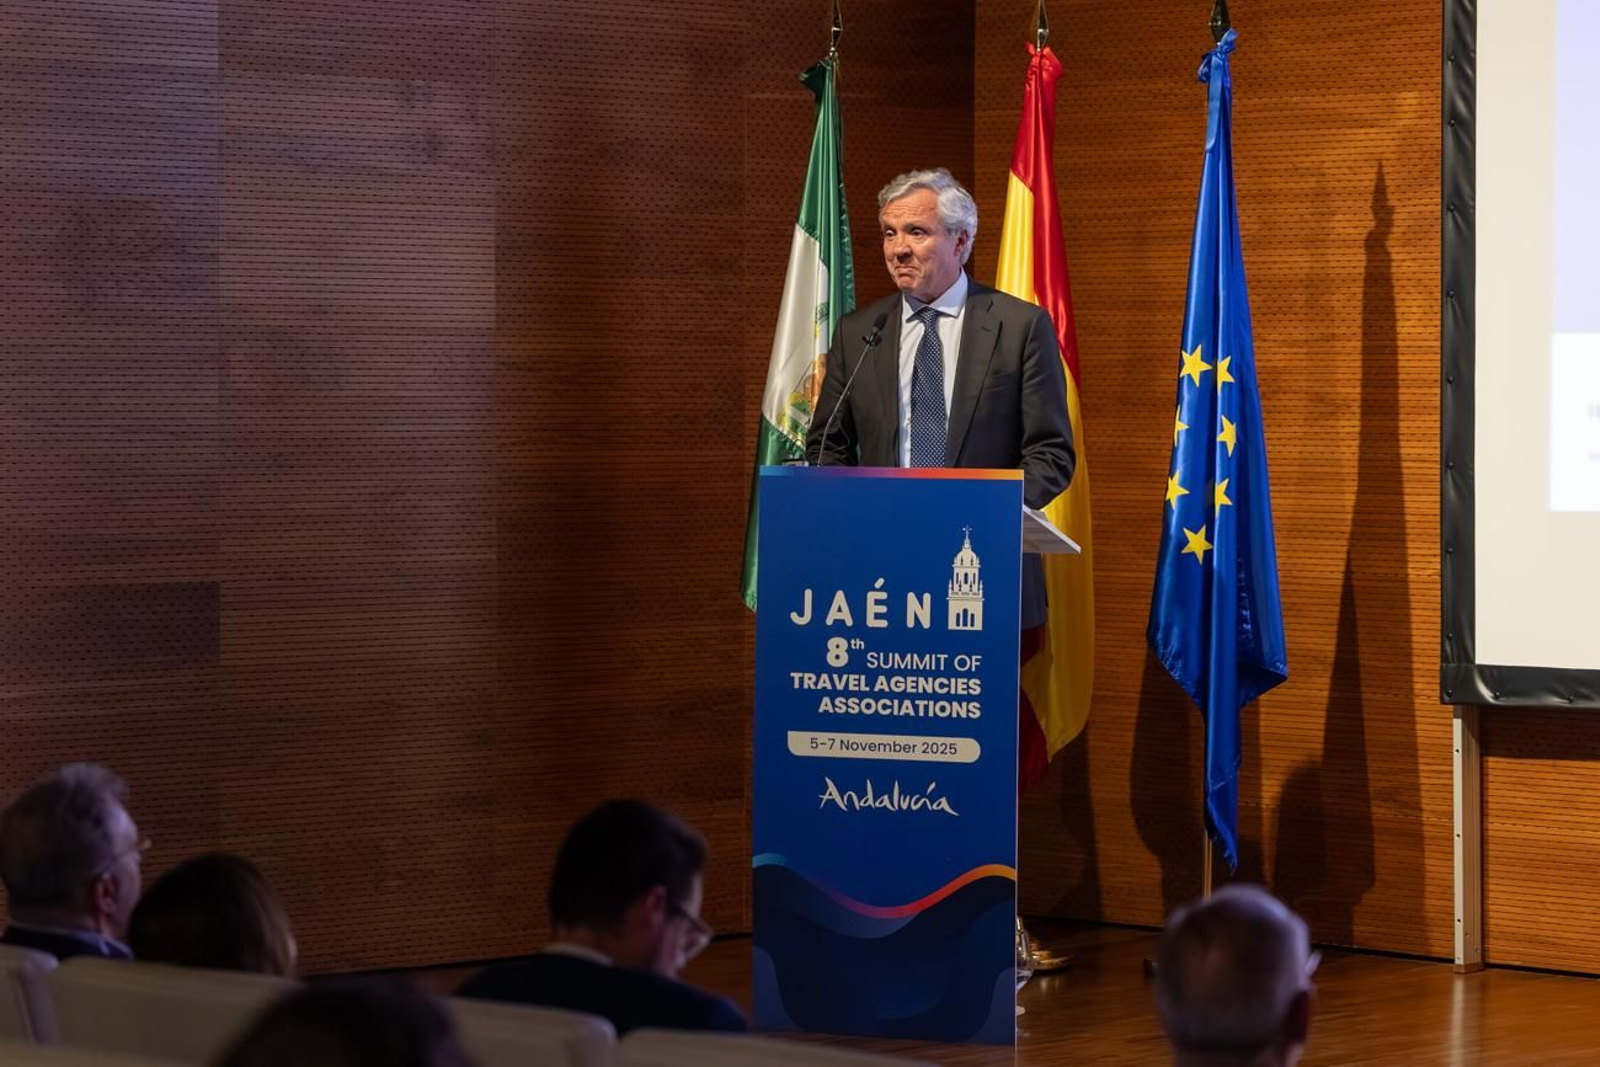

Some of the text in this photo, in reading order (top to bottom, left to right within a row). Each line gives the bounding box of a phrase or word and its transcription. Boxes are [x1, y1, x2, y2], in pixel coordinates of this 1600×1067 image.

[790, 577, 931, 629] JAÉN
[826, 636, 982, 672] 8th SUMMIT OF
[790, 672, 982, 695] TRAVEL AGENCIES
[818, 697, 981, 719] ASSOCIATIONS
[839, 738, 918, 754] November
[920, 741, 958, 756] 2025
[818, 776, 960, 816] Andalucía
